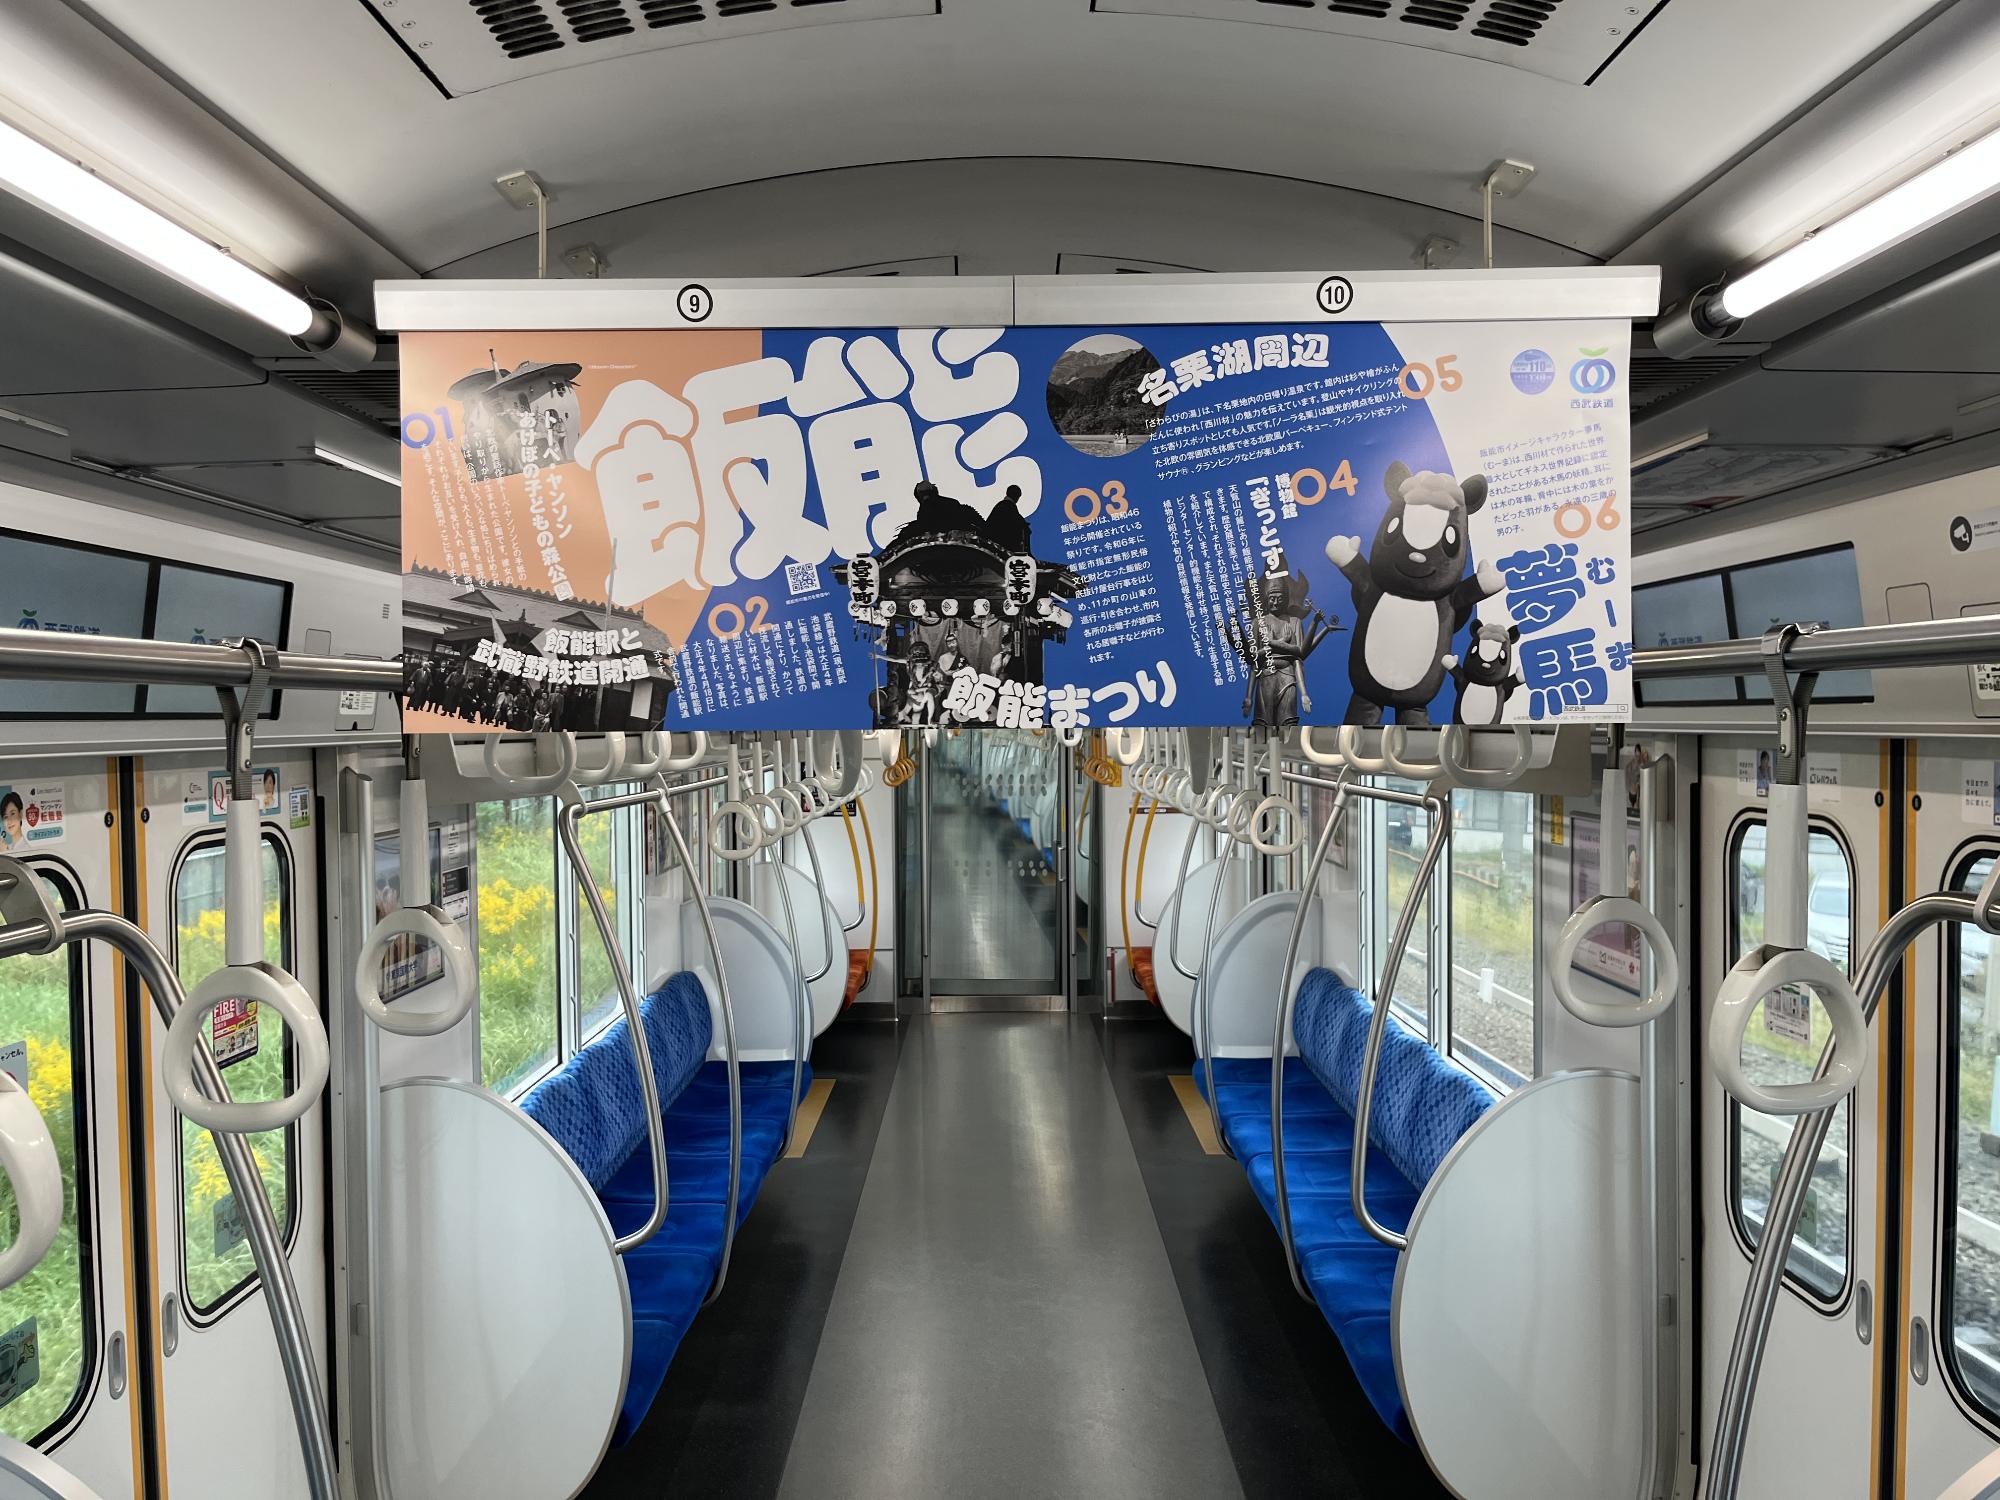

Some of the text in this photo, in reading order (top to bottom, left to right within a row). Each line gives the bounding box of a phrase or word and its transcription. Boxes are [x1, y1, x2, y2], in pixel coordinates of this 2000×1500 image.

[689, 295, 701, 313] 9
[1325, 287, 1345, 305] 10
[1137, 333, 1329, 406] 名栗湖周辺
[1399, 354, 1463, 399] 05
[1570, 399, 1614, 408] 西武鉄道
[402, 407, 454, 448] 01
[543, 411, 573, 539] トーベ・ヤンソン
[574, 328, 1042, 606] 飯能
[1288, 460, 1358, 505] 04
[519, 411, 574, 601] あけぼの子どもの森公園
[1064, 480, 1128, 523] 03
[1275, 473, 1298, 519] 博物館
[1554, 495, 1620, 538] 06
[1064, 522, 1143, 546] 年から開催されている
[1066, 535, 1145, 560] 祭りです。令和6年に
[1496, 525, 1524, 537] 男の子。
[852, 559, 874, 604] 宮本町
[1009, 559, 1030, 604] 宮本町
[1072, 561, 1150, 586] 文化財となった飯能の
[1075, 573, 1153, 599] 底抜け屋台行事をはじ
[708, 596, 774, 640] 02
[1084, 613, 1162, 638] 各所のお囃子が披露さ
[1496, 543, 1608, 721] 夢馬
[470, 638, 650, 685] 武蔵野鉄道開通
[543, 627, 643, 655] 飯能駅と
[1089, 653, 1115, 664] れます。
[942, 660, 1177, 729] 飯能まつり
[214, 999, 235, 1017] FIRE
